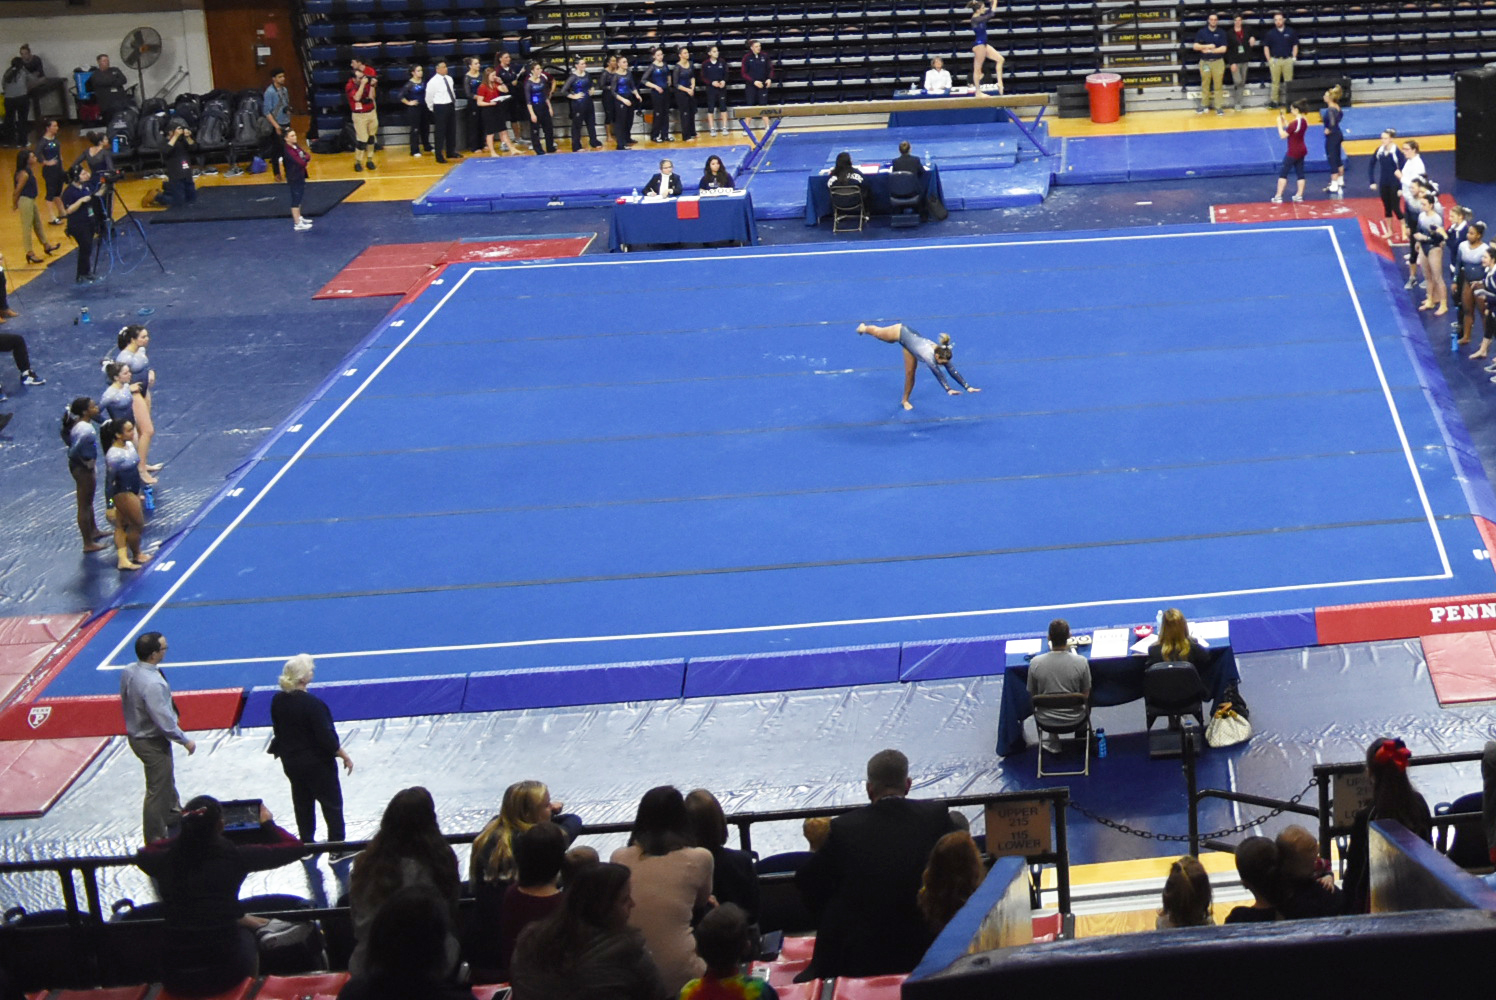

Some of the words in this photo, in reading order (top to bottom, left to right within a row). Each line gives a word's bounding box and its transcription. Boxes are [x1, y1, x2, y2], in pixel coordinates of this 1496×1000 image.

[1429, 602, 1496, 623] PENN
[998, 807, 1038, 818] UPPER
[1009, 817, 1029, 827] 215
[1011, 831, 1028, 840] 115
[998, 839, 1041, 851] LOWER
